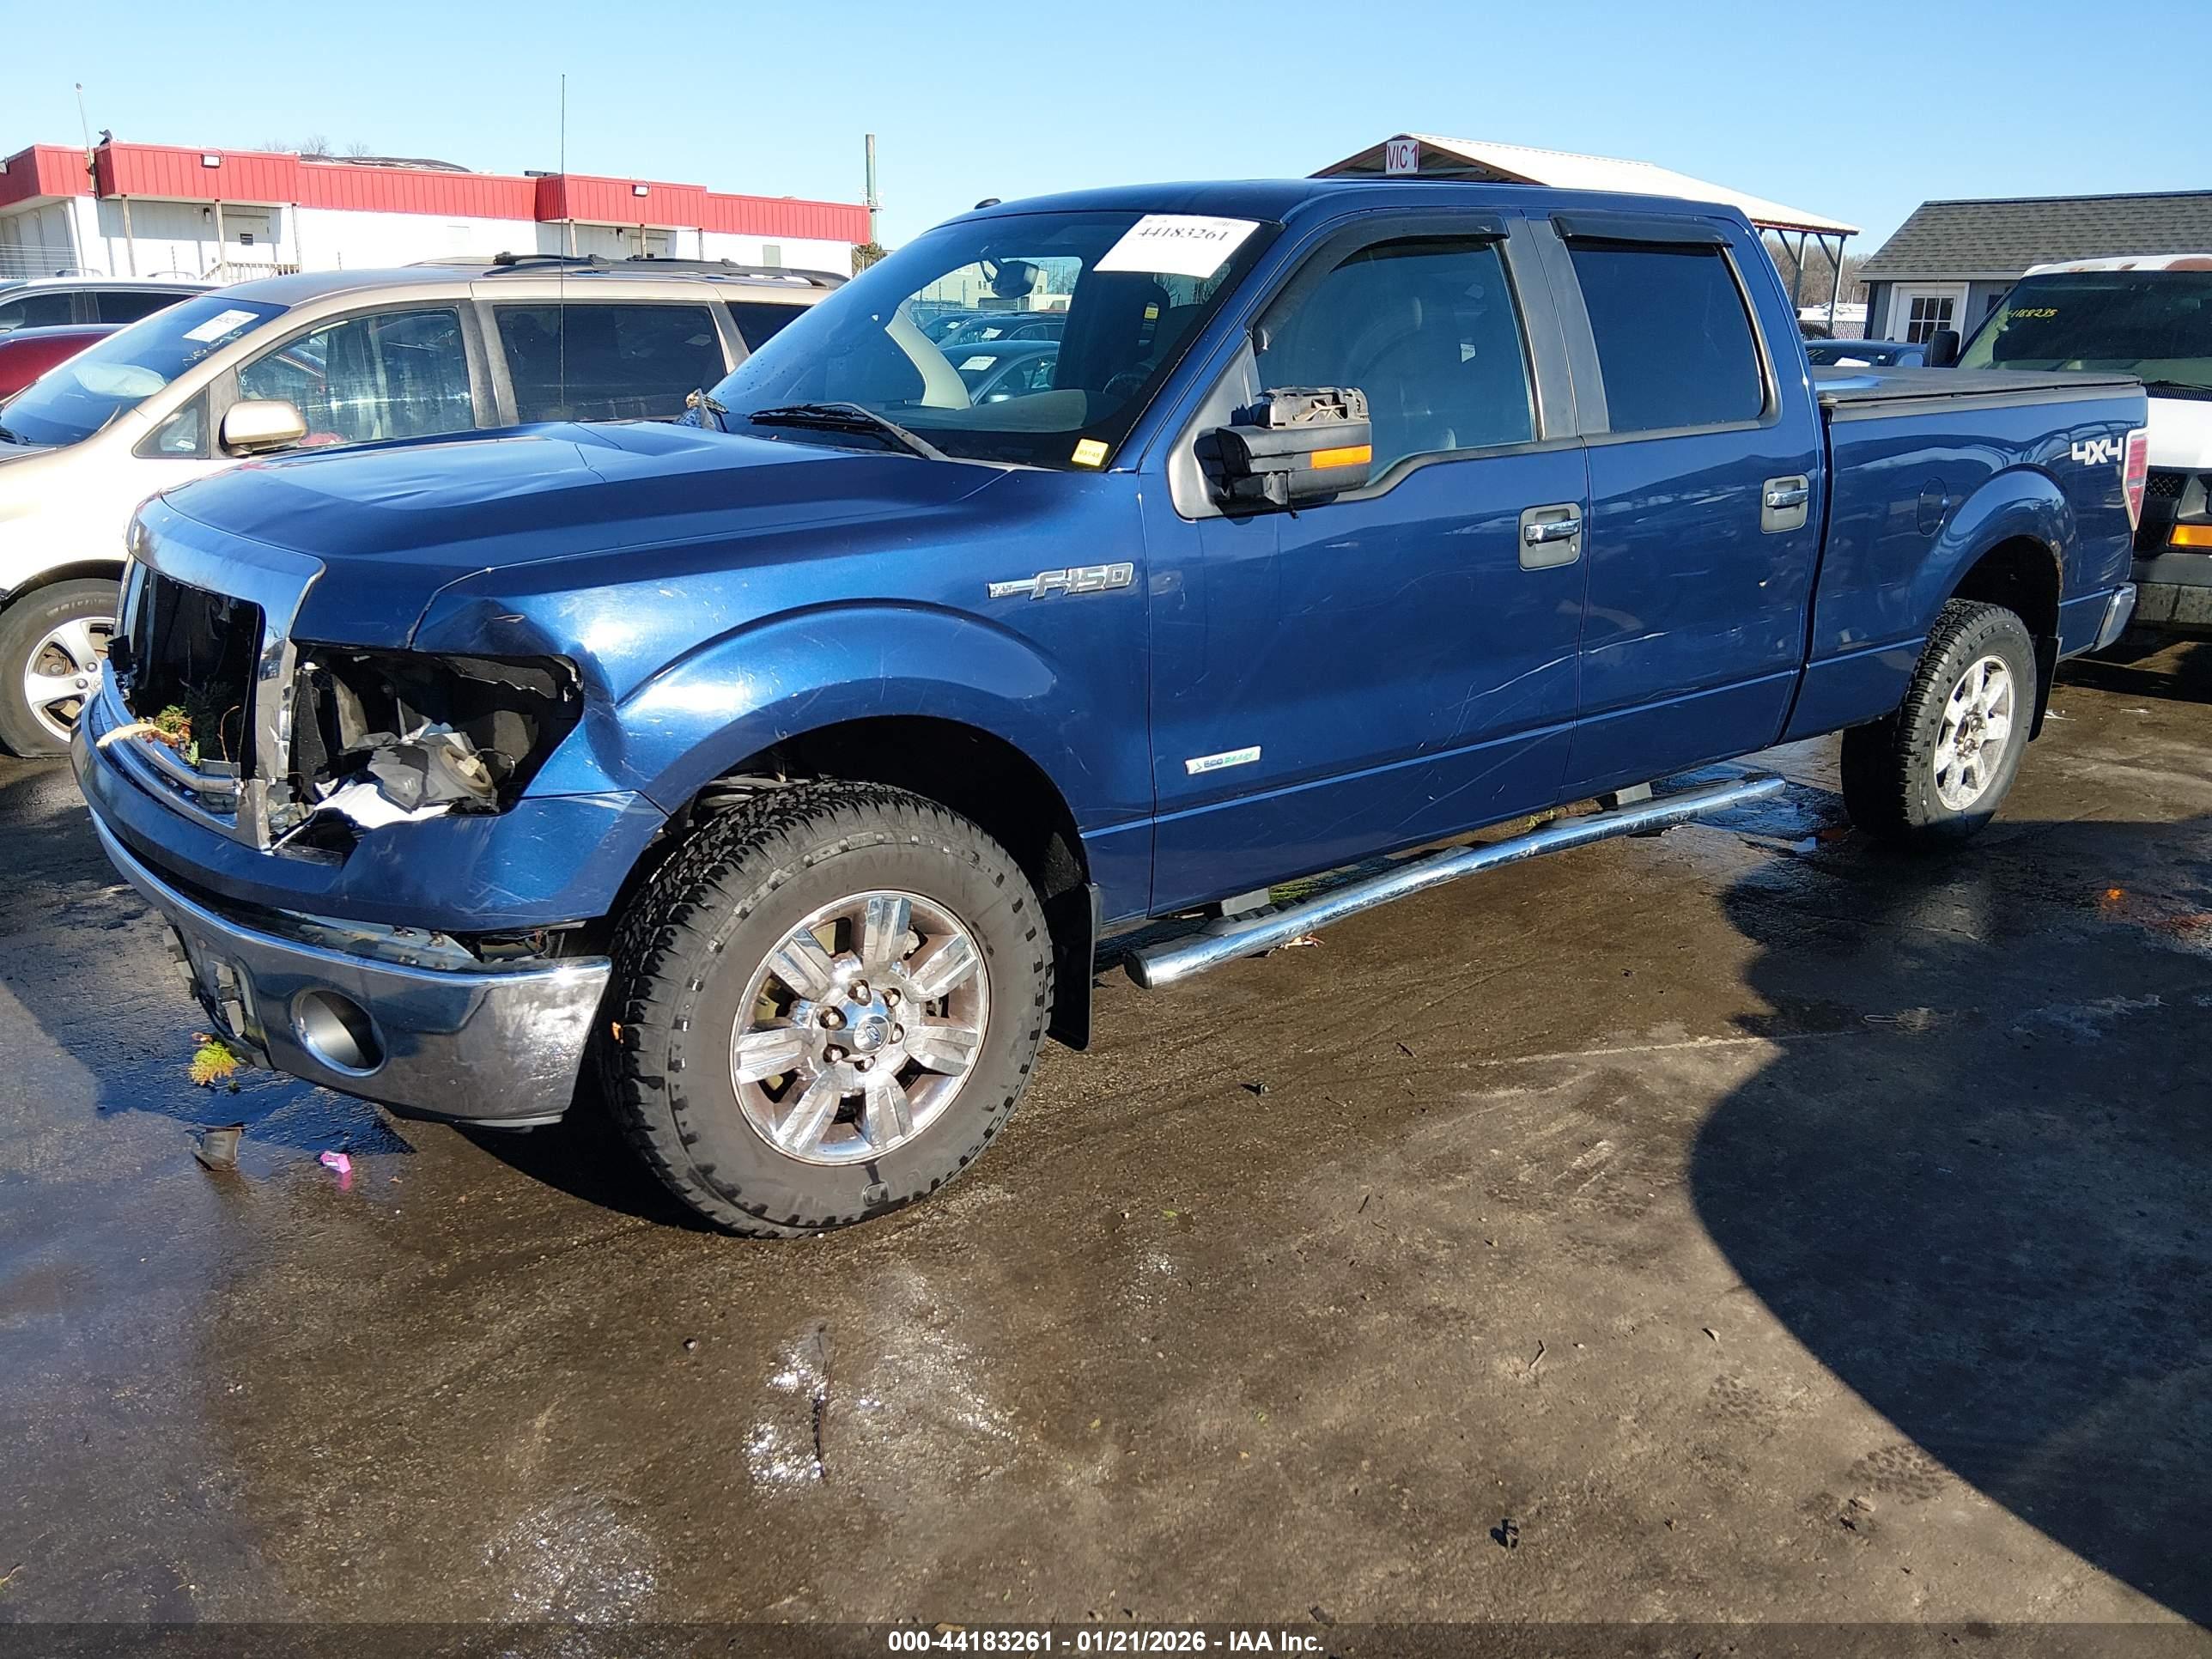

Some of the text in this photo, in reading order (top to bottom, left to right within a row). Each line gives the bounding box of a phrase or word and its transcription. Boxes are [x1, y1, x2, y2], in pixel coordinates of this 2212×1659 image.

[1388, 143, 1419, 169] VIC 1
[1137, 227, 1229, 241] 44183261
